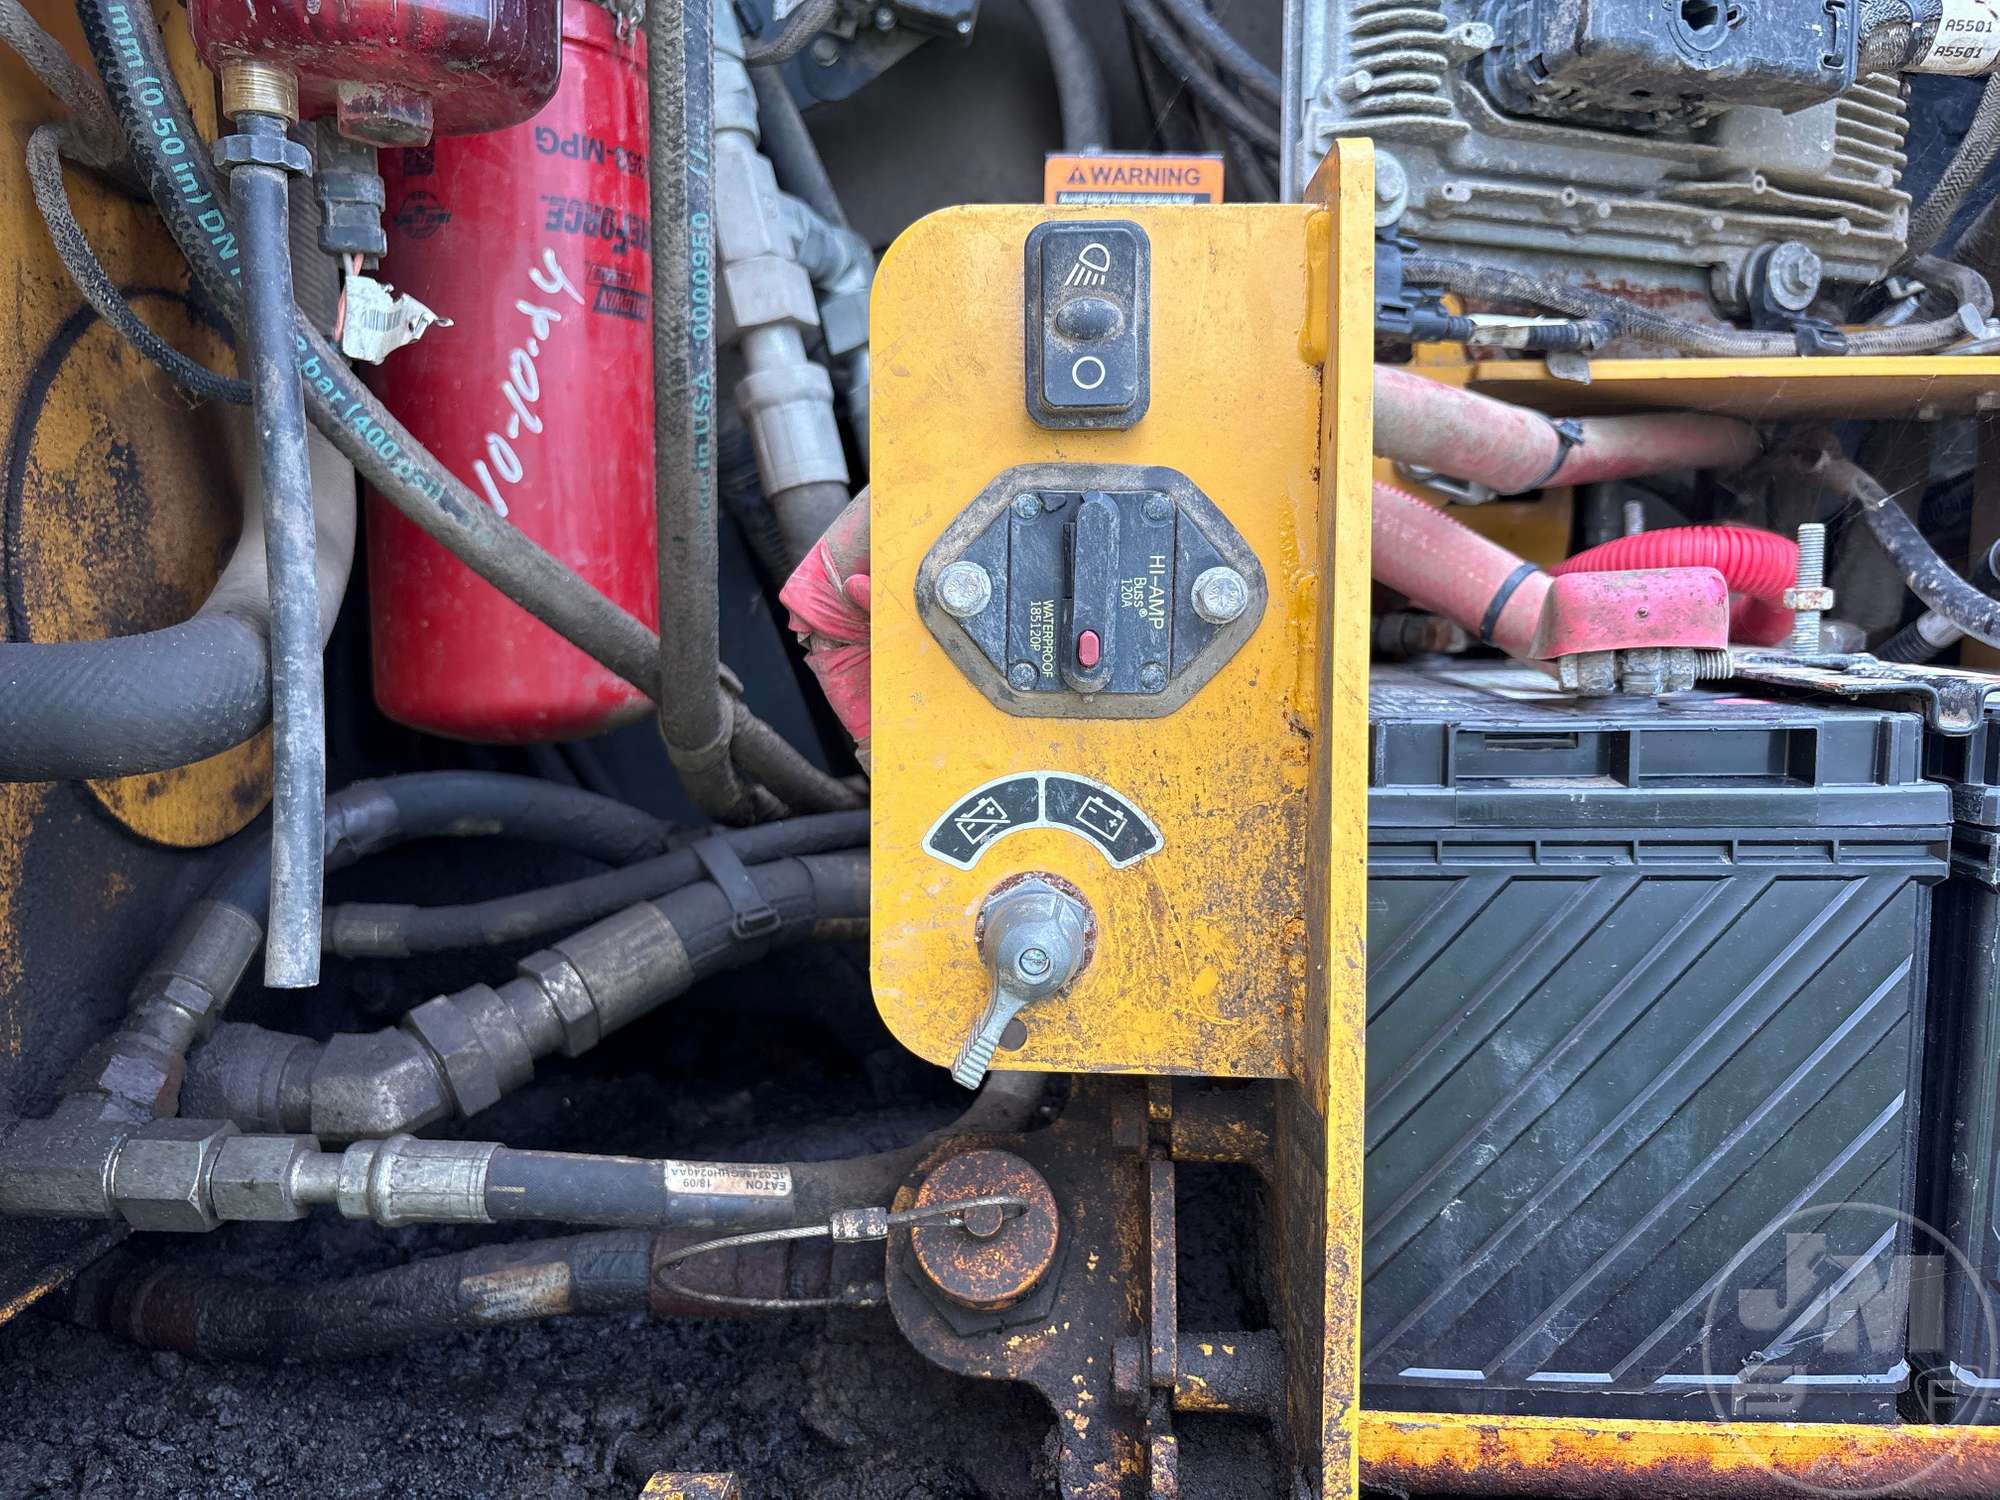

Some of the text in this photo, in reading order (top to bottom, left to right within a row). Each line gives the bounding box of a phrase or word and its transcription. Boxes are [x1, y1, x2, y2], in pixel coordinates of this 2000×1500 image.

[1945, 19, 1992, 33] A5501
[1934, 46, 1983, 59] A5501
[108, 4, 240, 260] mm (0.50 in) DN
[1091, 167, 1200, 186] WARNING
[690, 210, 711, 341] 0000950
[302, 355, 346, 403] bar
[341, 403, 398, 461] (400
[690, 368, 712, 436] USA
[1121, 578, 1133, 609] 120A
[1030, 600, 1041, 652] 185120P
[1042, 599, 1054, 679] WATERPROOF
[745, 1181, 787, 1191] EATON
